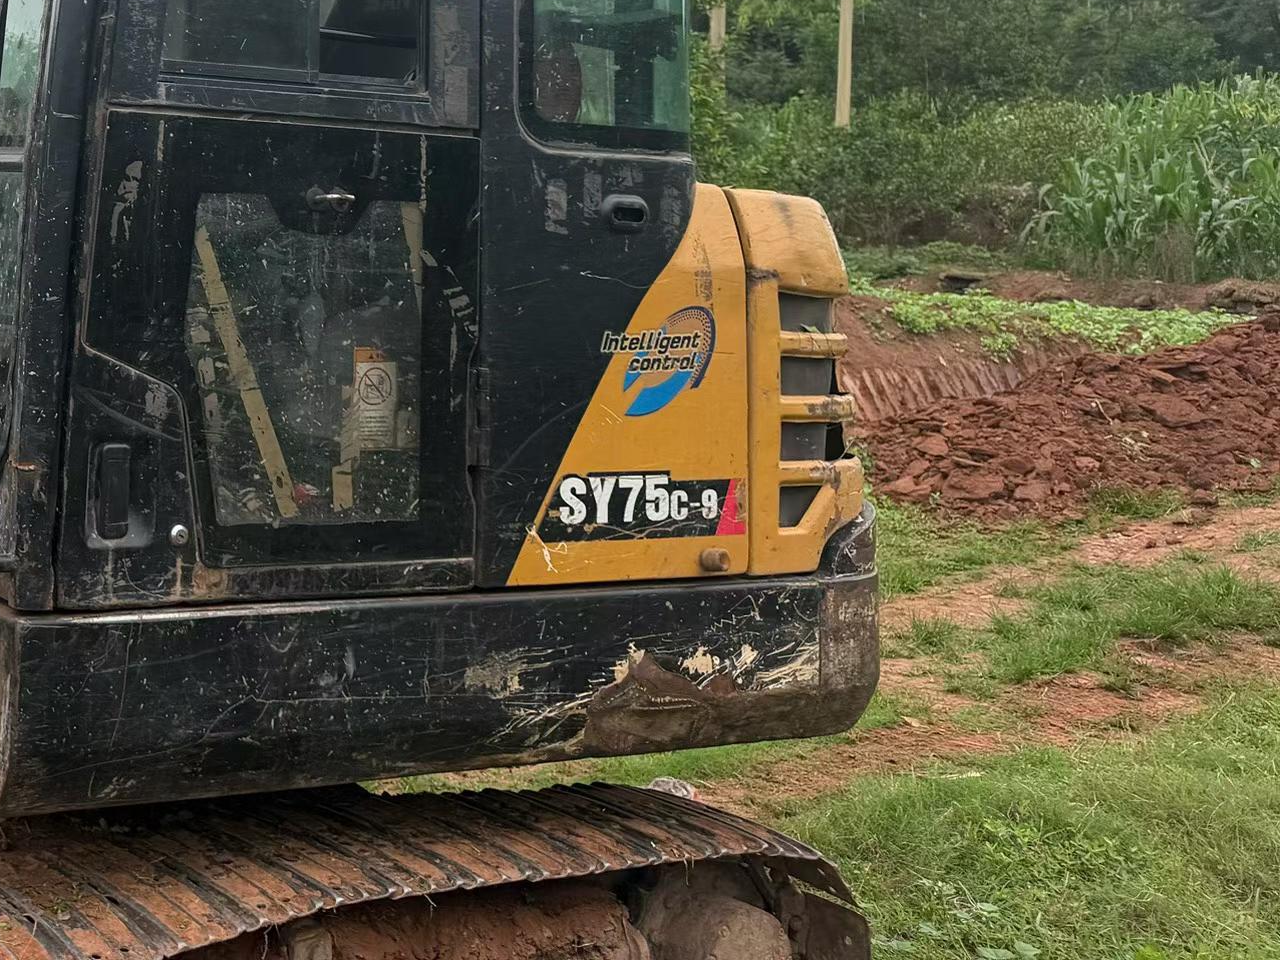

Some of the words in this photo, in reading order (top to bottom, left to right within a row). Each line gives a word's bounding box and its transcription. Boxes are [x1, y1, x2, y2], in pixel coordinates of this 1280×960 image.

[601, 330, 701, 354] Intelligent
[628, 351, 698, 373] control
[559, 475, 718, 525] SY75C-9
